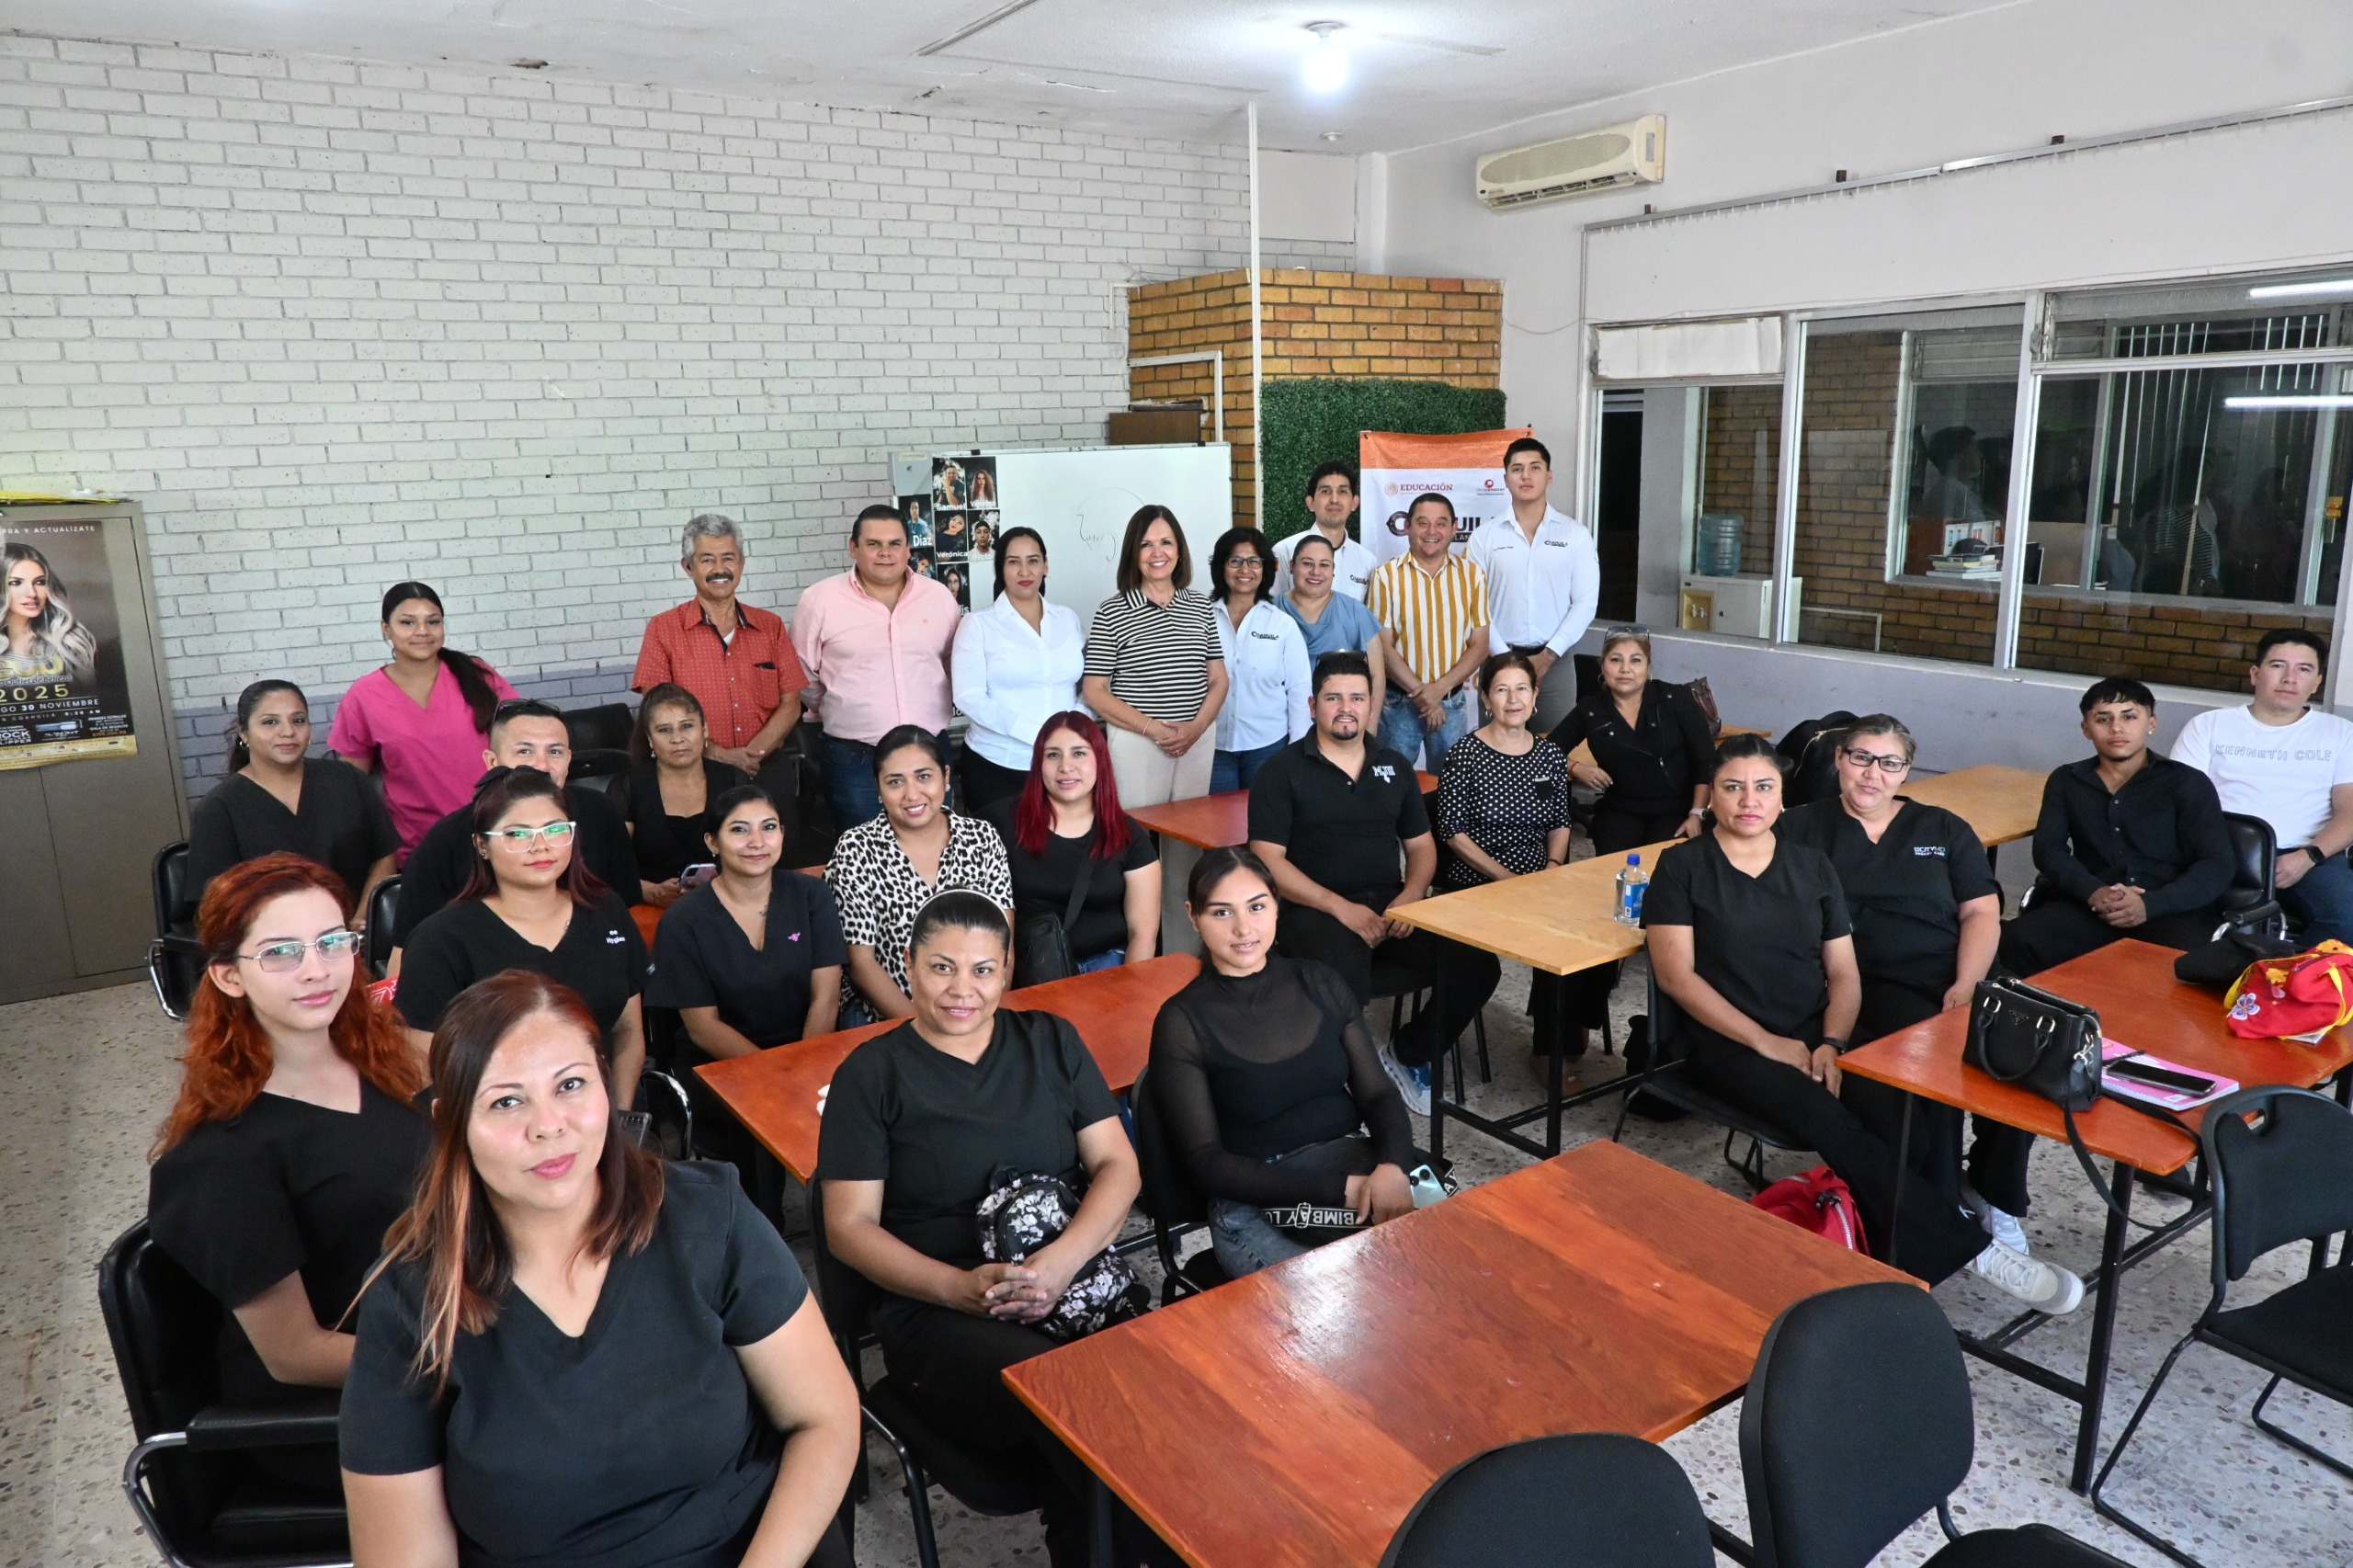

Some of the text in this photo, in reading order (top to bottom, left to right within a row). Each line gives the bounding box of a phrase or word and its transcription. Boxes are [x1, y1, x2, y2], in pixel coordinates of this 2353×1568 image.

[1400, 482, 1453, 492] EDUCACIÓN
[913, 535, 933, 547] Diaz
[937, 550, 968, 559] Verónica
[0, 683, 69, 702] 2025
[40, 699, 99, 710] NOVIEMBRE
[2214, 744, 2332, 762] KENNETH COLE
